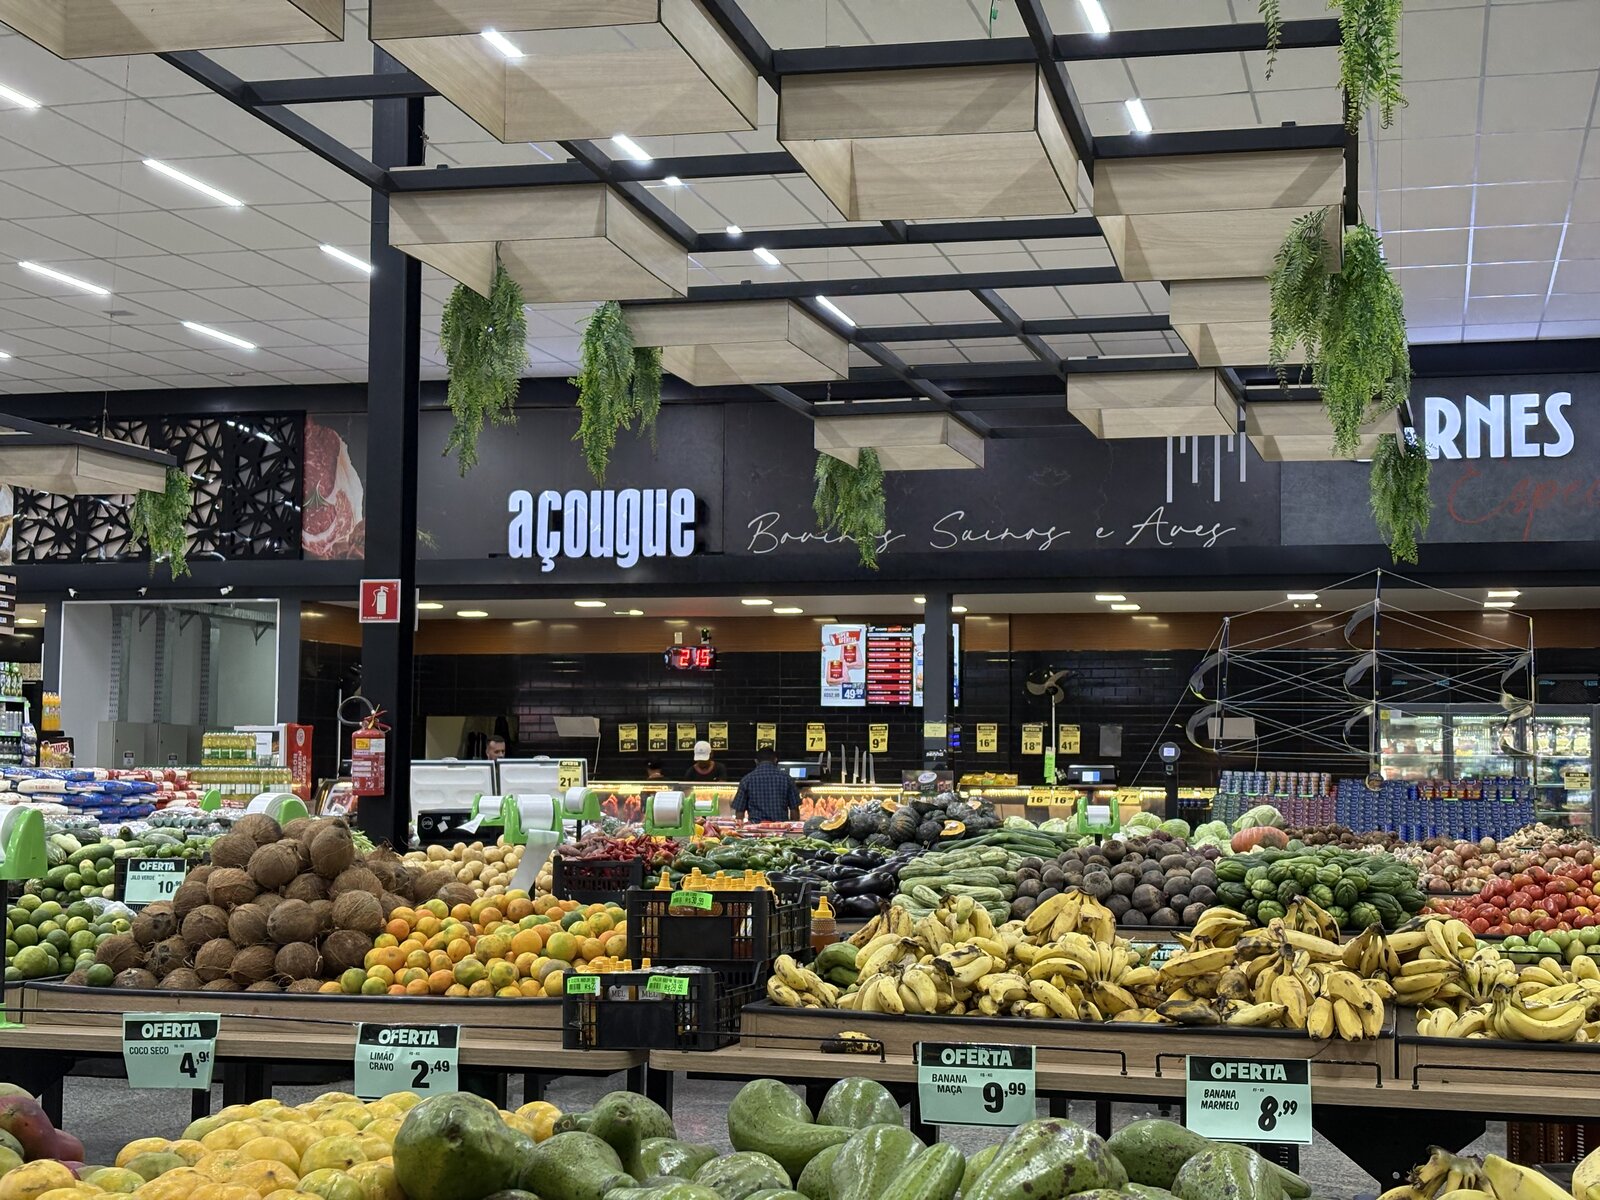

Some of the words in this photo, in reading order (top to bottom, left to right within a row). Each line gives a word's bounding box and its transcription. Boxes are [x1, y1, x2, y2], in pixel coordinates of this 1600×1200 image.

[1404, 391, 1575, 460] RNES
[508, 488, 696, 572] açougue
[746, 511, 906, 554] Bovins
[1094, 527, 1114, 540] e
[1125, 505, 1236, 548] Aves
[138, 861, 176, 871] OFERTA
[141, 1022, 202, 1039] OFERTA
[378, 1028, 440, 1046] OFERTA
[129, 1046, 149, 1055] COCO
[150, 1046, 170, 1055] SECO
[369, 1050, 395, 1062] LIMÃO
[940, 1048, 1013, 1067] OFERTA
[368, 1061, 395, 1072] CRAVO
[410, 1059, 450, 1089] 2,49
[1210, 1062, 1288, 1081] OFERTA
[931, 1073, 968, 1084] BANANA
[937, 1084, 963, 1096] MAÇA
[982, 1081, 1027, 1114] 9,99
[1203, 1088, 1237, 1100] BANANA
[1200, 1099, 1240, 1111] MARMELO
[1257, 1095, 1299, 1132] 8,99
